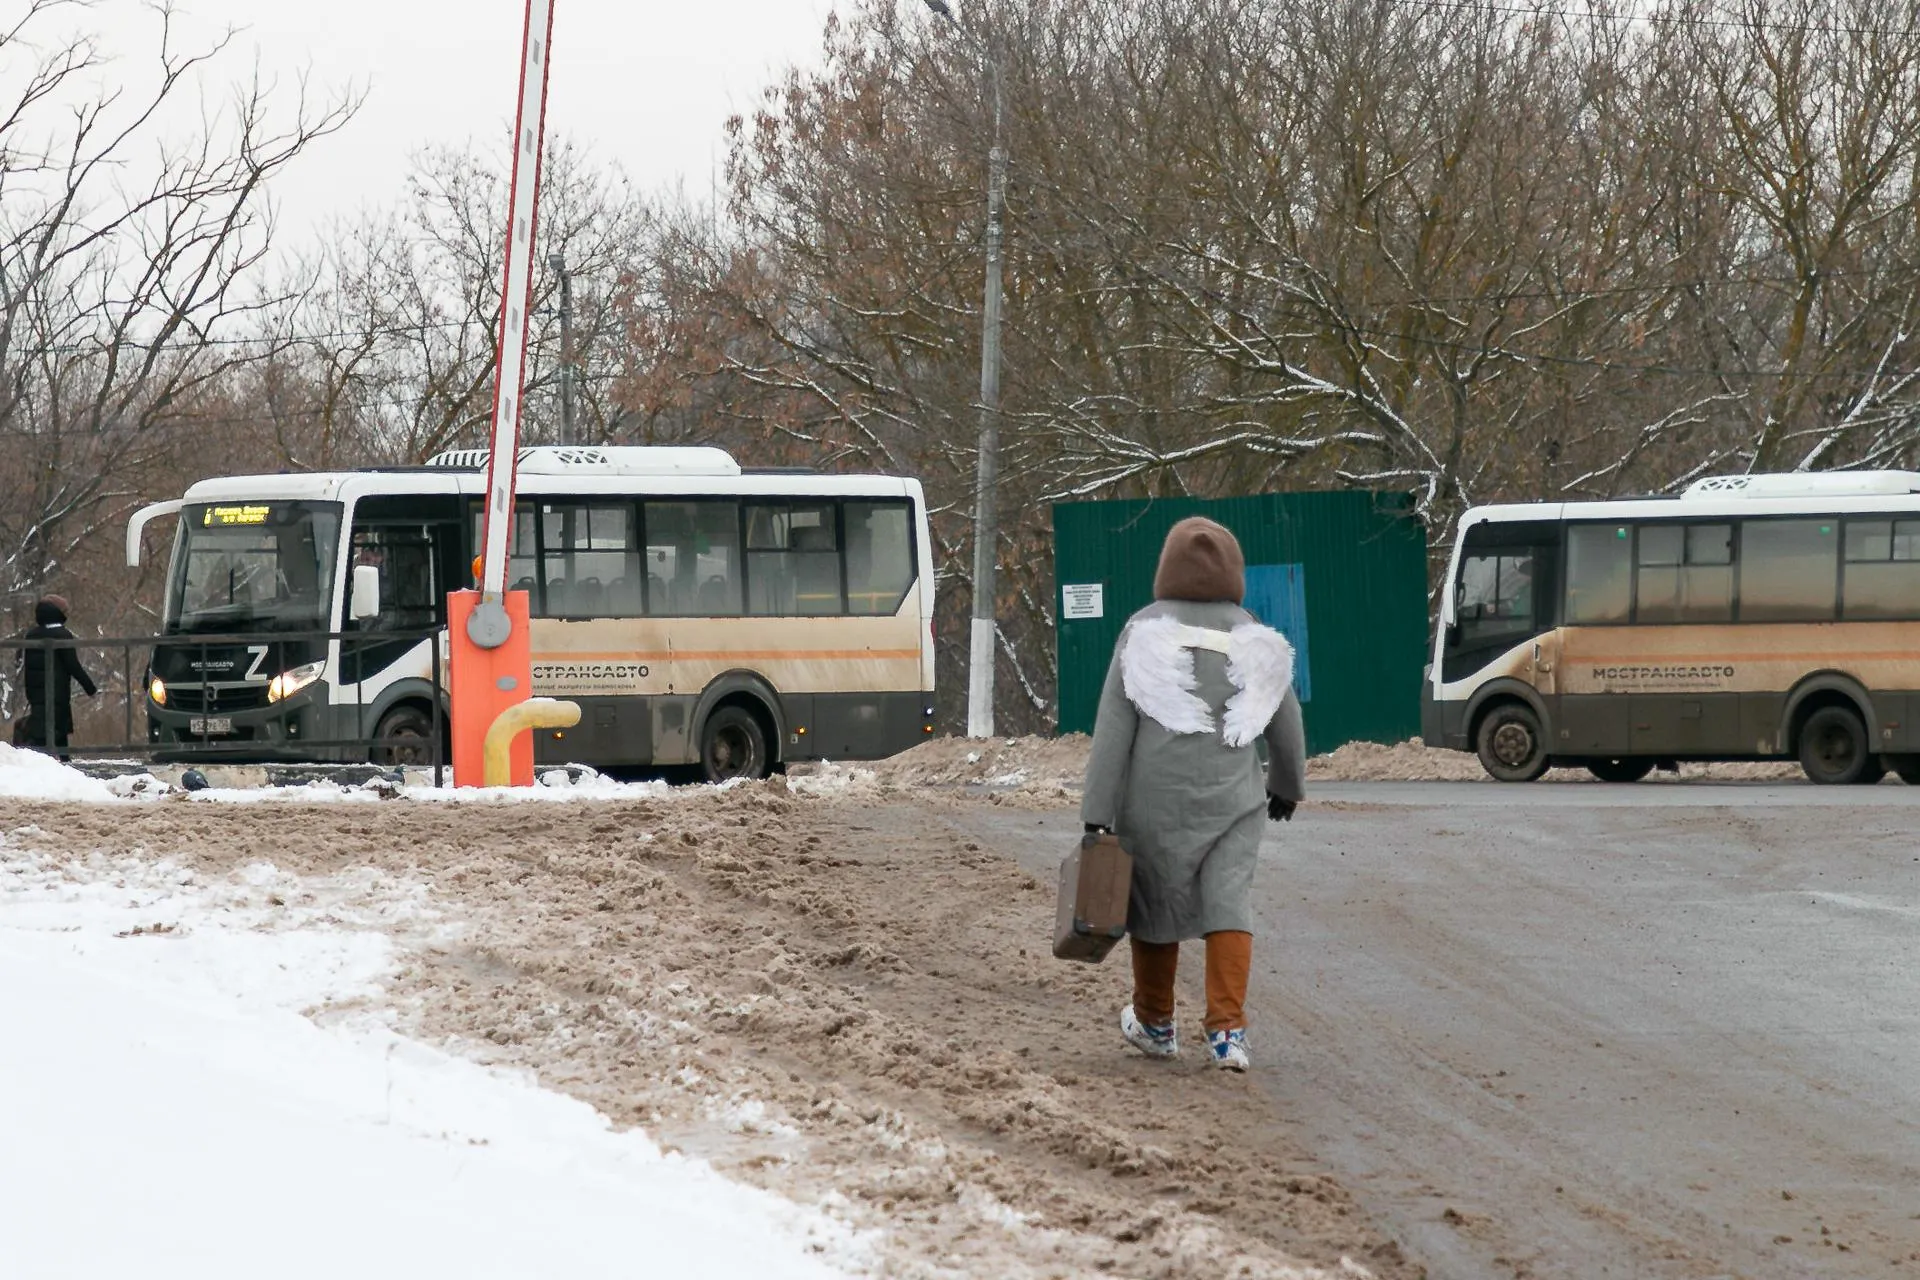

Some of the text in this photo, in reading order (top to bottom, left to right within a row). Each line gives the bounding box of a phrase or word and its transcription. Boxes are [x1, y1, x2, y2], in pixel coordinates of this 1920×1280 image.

[245, 645, 269, 681] Z
[533, 665, 649, 679] СТРАНСАВТО
[1592, 666, 1735, 679] МОСТРАНСАВТО
